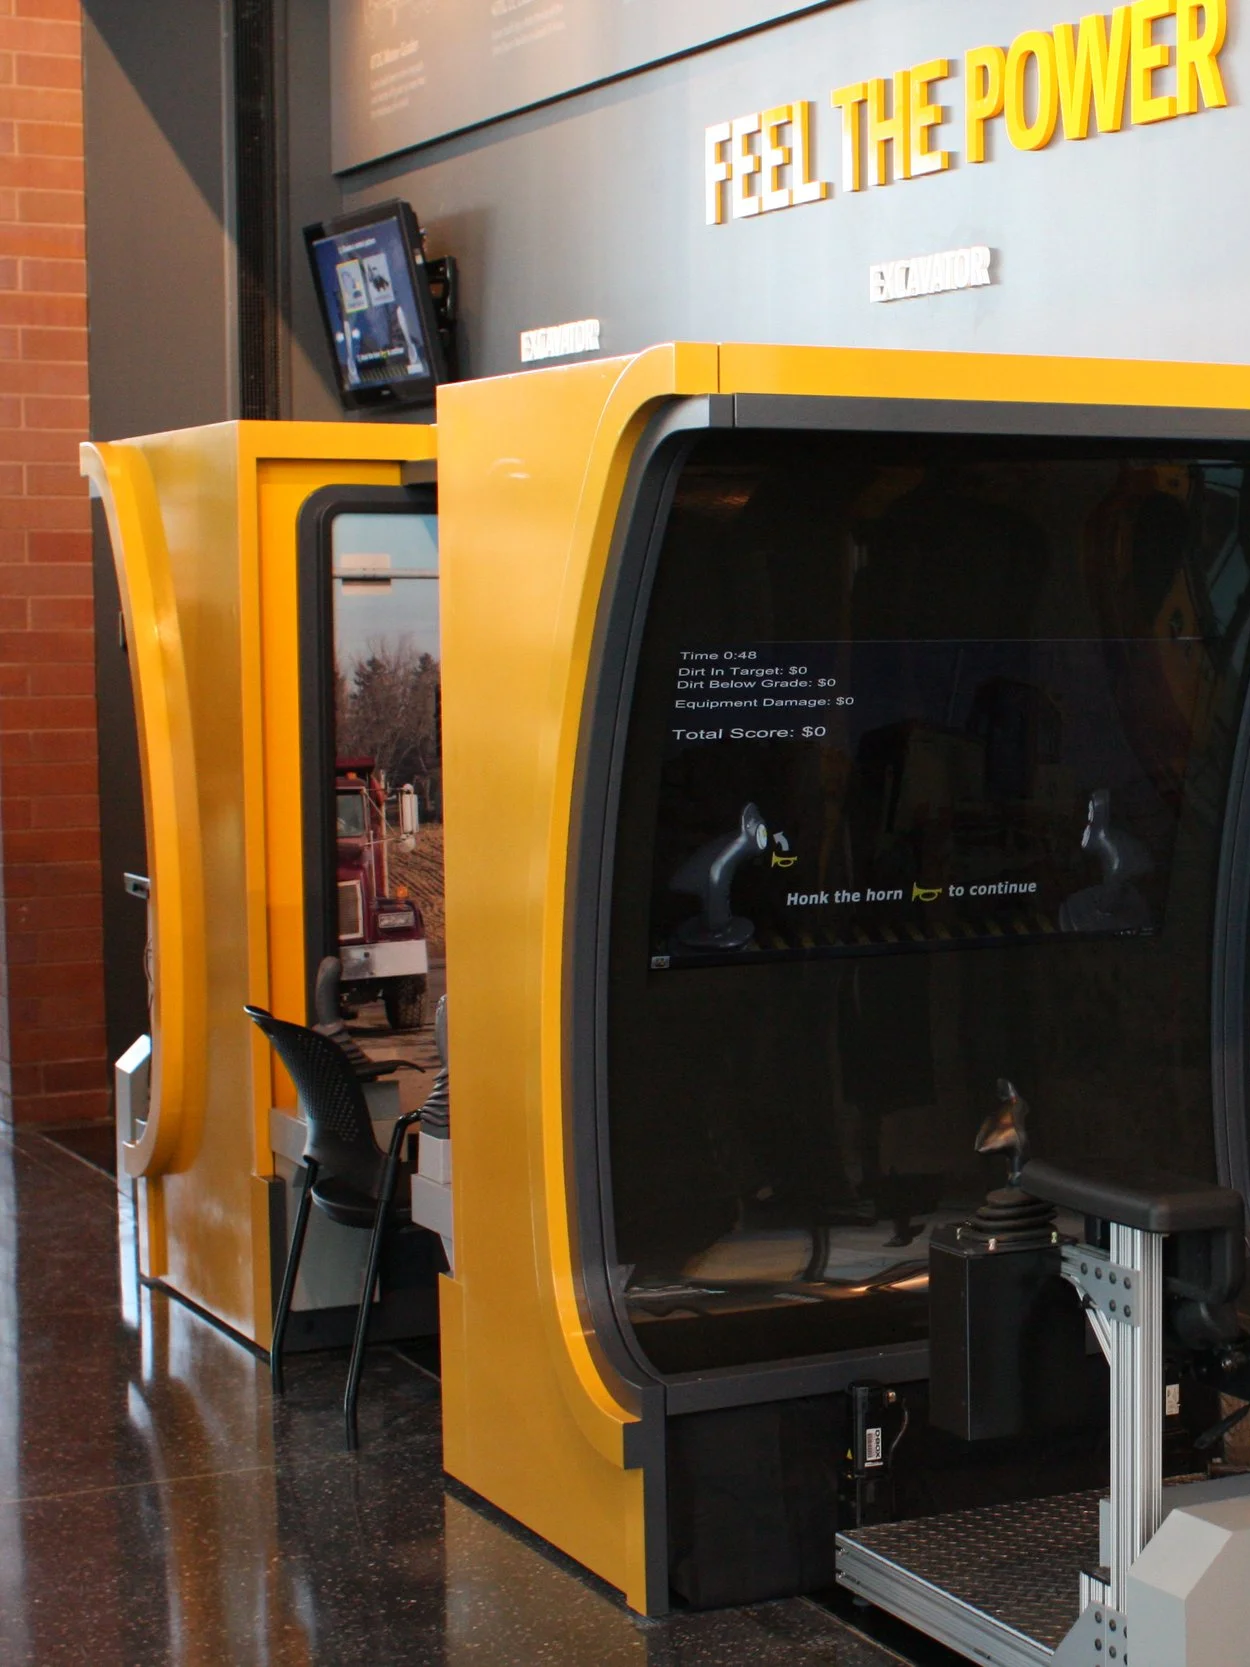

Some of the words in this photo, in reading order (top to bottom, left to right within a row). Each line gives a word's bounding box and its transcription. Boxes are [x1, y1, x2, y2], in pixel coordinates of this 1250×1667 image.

[705, 100, 827, 225] FEEL
[831, 58, 948, 192] THE
[965, 0, 1228, 163] POWER
[869, 245, 991, 303] EXCAVATOR
[680, 651, 719, 660] Time
[723, 651, 757, 660] 0:48
[678, 668, 706, 677] Dirt
[711, 668, 724, 676] In
[729, 667, 784, 678] Target:
[788, 666, 808, 676] $0
[677, 680, 704, 689] Dirt
[709, 680, 757, 689] Below
[761, 679, 812, 688] Grade:
[817, 678, 836, 688] $0
[675, 698, 758, 710] Equipment
[762, 698, 831, 708] Damage:
[835, 697, 854, 706] $0
[672, 728, 723, 740] Total
[729, 728, 794, 739] Score:
[801, 726, 827, 738] $0
[786, 890, 829, 906] Honk
[834, 889, 861, 904] the
[865, 887, 903, 902] horn
[948, 884, 966, 898] to
[969, 879, 1037, 897] continue
